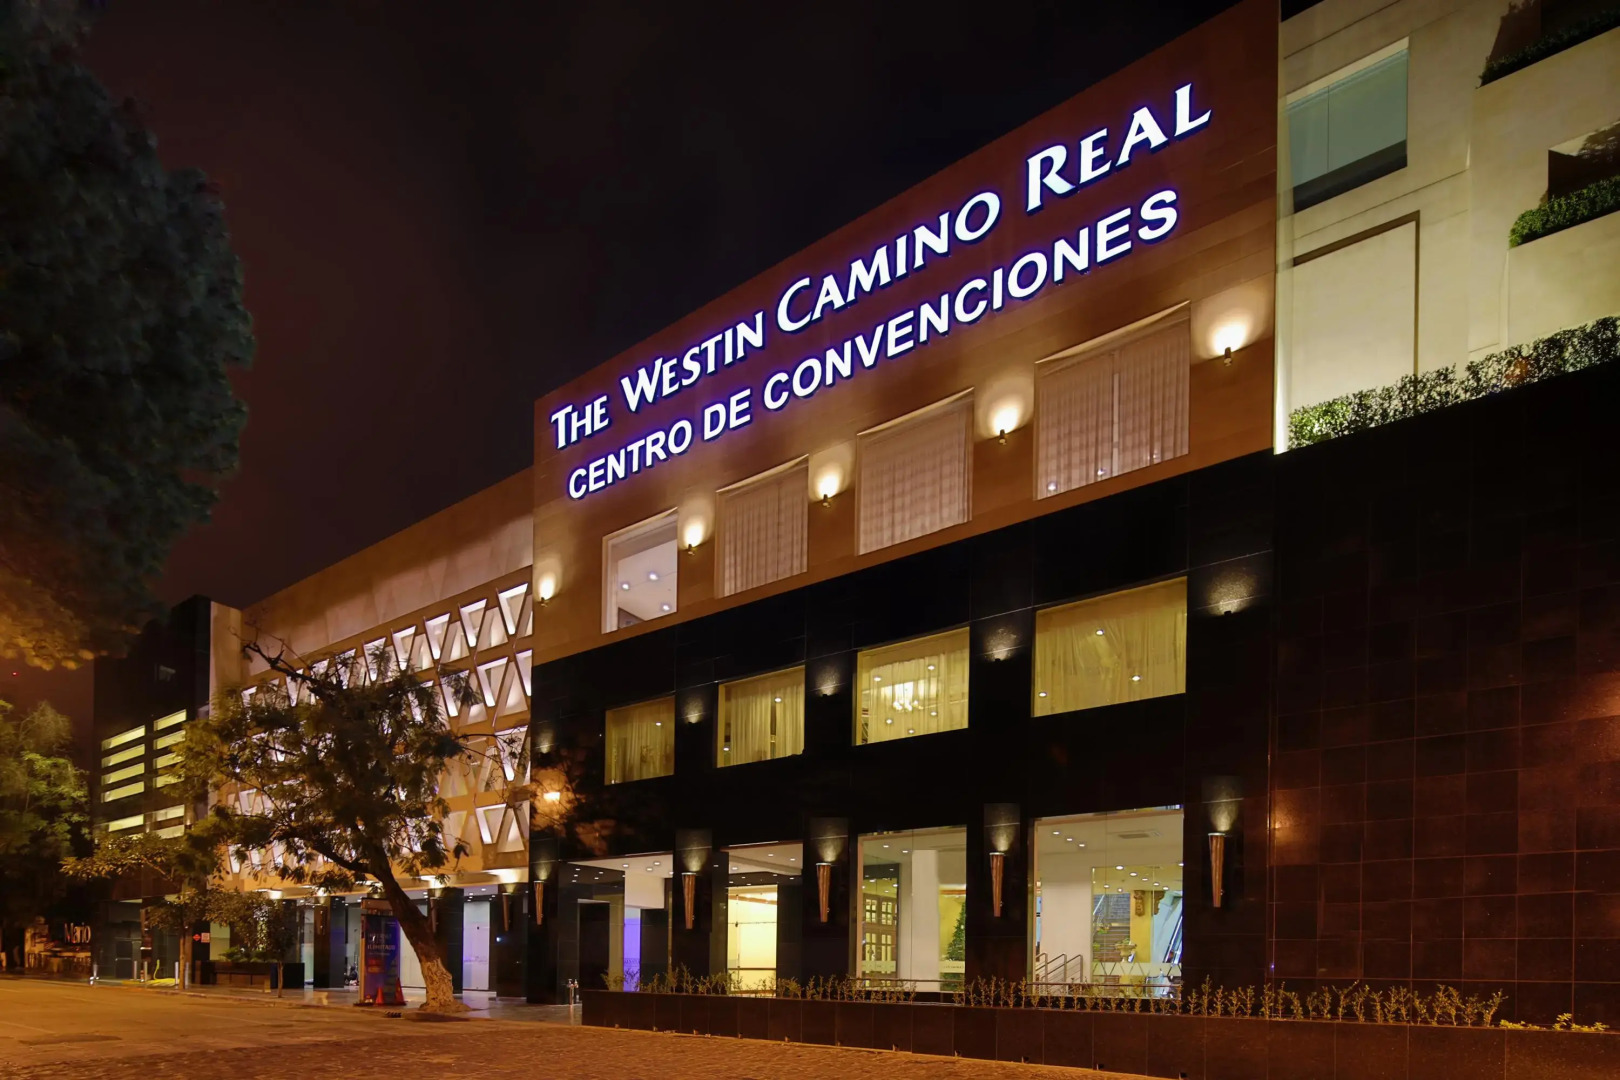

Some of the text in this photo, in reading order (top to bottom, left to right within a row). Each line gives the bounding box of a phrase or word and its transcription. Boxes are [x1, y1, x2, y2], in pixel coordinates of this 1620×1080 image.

[550, 83, 1212, 449] THE WESTIN CAMINO REAL
[568, 189, 1178, 500] CENTRO DE CONVENCIONES
[64, 922, 92, 944] Mario
